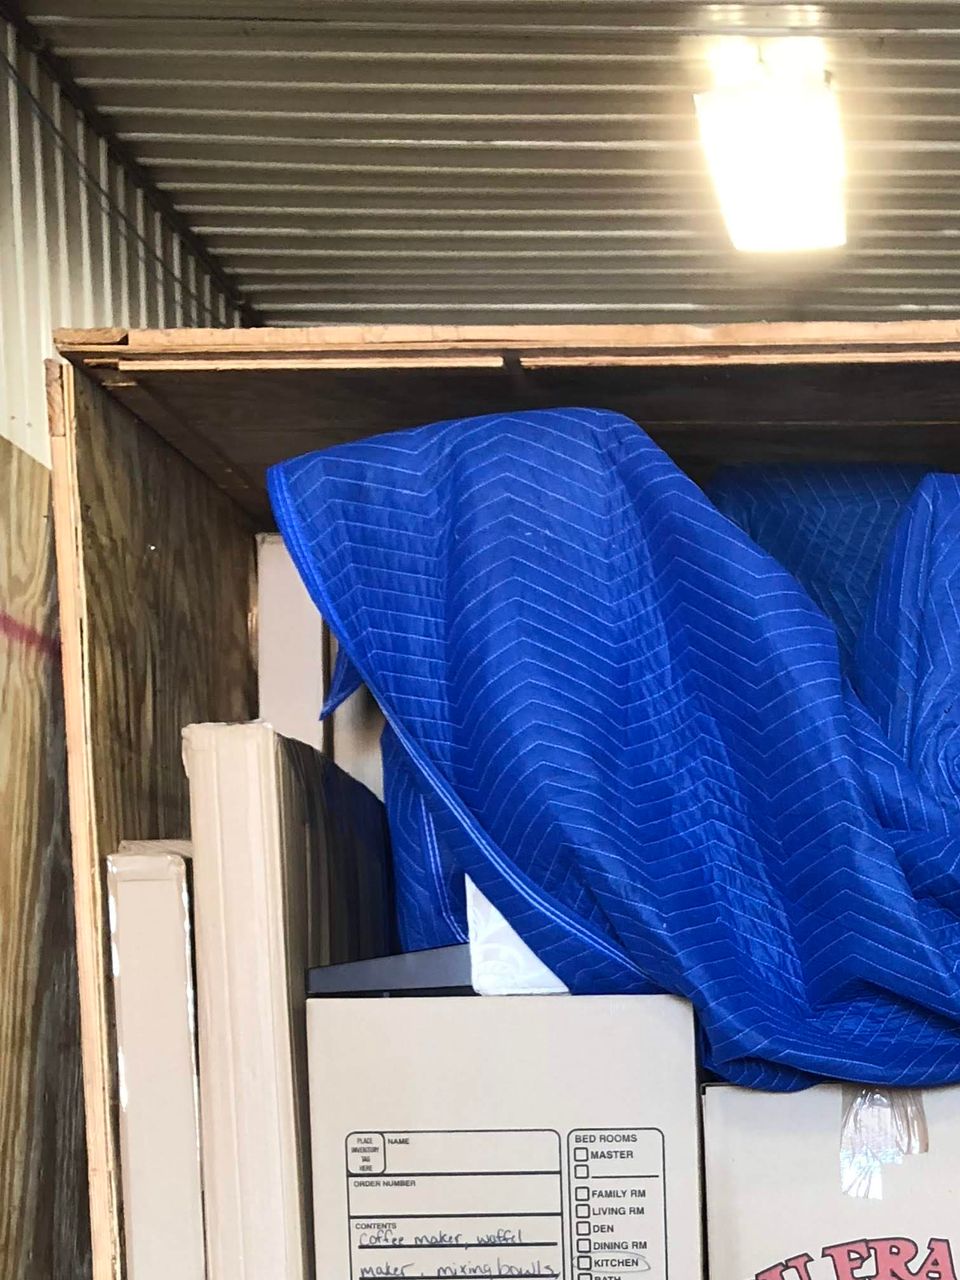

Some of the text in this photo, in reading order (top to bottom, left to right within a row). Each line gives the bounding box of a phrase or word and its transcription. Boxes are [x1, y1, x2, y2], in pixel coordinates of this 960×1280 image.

[575, 1134, 637, 1143] BED ROOMS
[590, 1151, 633, 1159] MASTER
[592, 1189, 646, 1198] FAMILY RM
[592, 1206, 644, 1216] LIVING RM
[593, 1224, 614, 1233] DEN
[593, 1241, 647, 1250] DINING RM
[594, 1258, 638, 1267] KITCHEN
